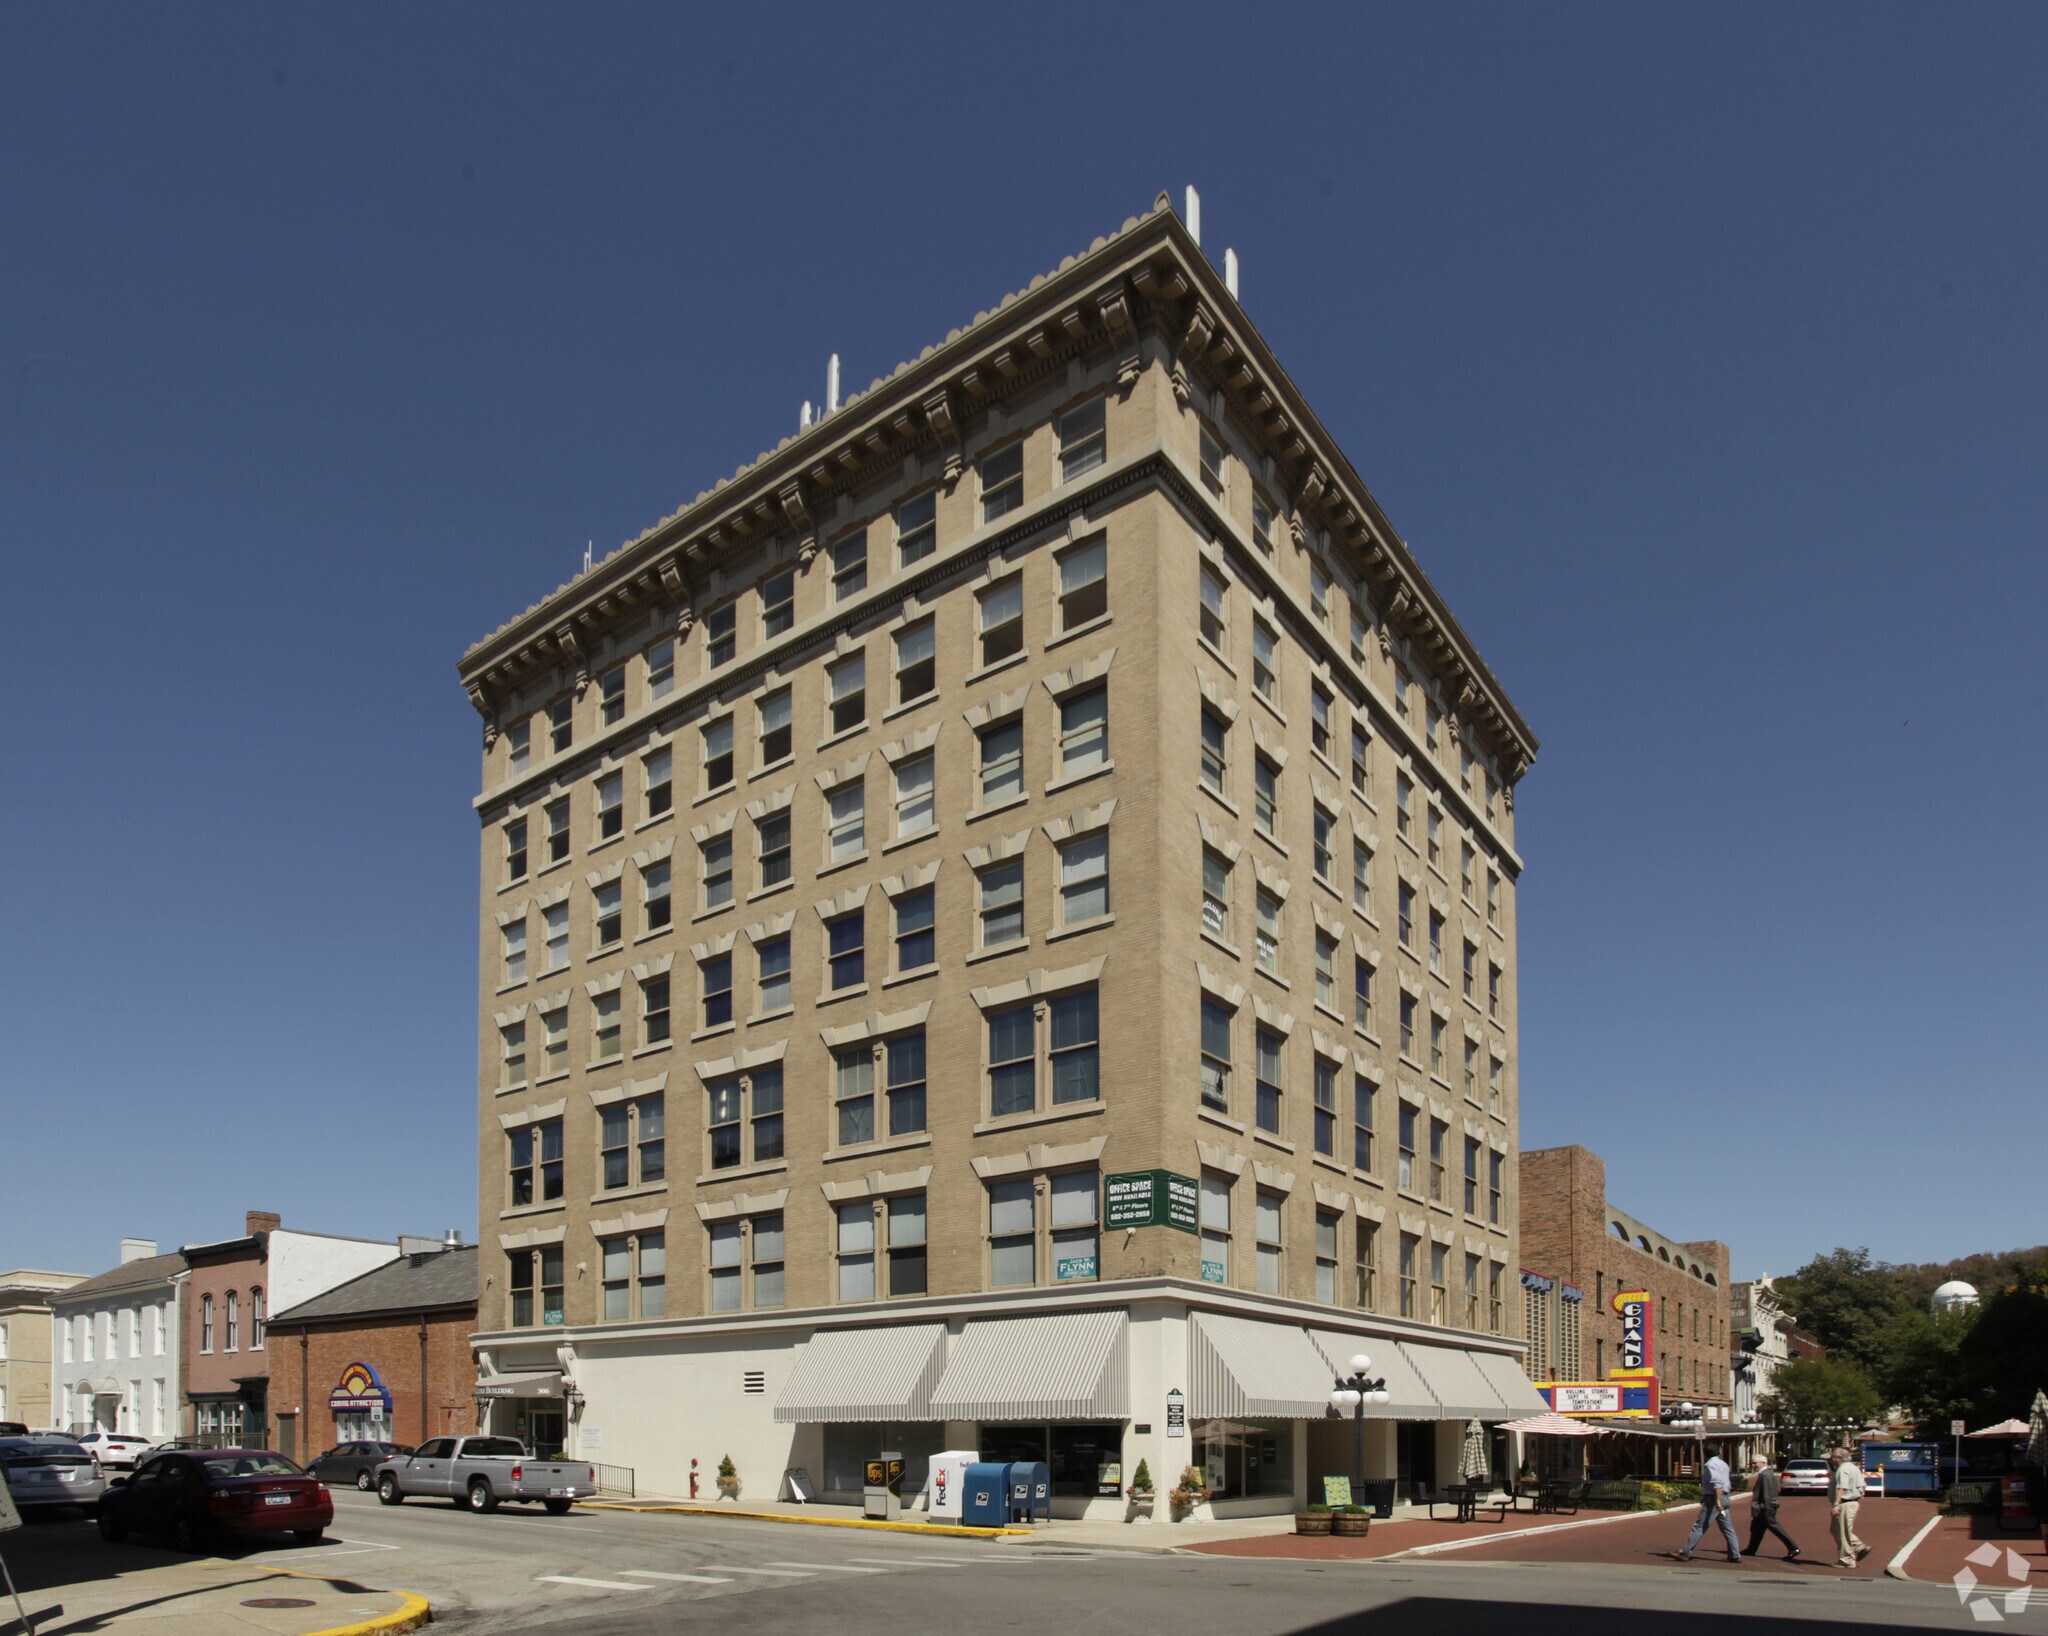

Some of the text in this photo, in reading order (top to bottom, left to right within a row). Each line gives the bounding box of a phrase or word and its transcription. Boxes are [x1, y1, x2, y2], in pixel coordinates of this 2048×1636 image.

[1110, 1180, 1152, 1194] OFFICE SPACE
[1170, 1182, 1196, 1198] OFFICE SPACE
[1123, 1192, 1151, 1200] AVAILABLE
[1060, 1262, 1094, 1272] FLYNN
[1202, 1264, 1223, 1276] FLYNN
[1624, 1304, 1642, 1367] GRAND
[349, 1399, 384, 1407] ATTRACTIONS
[936, 1469, 946, 1506] FedEx
